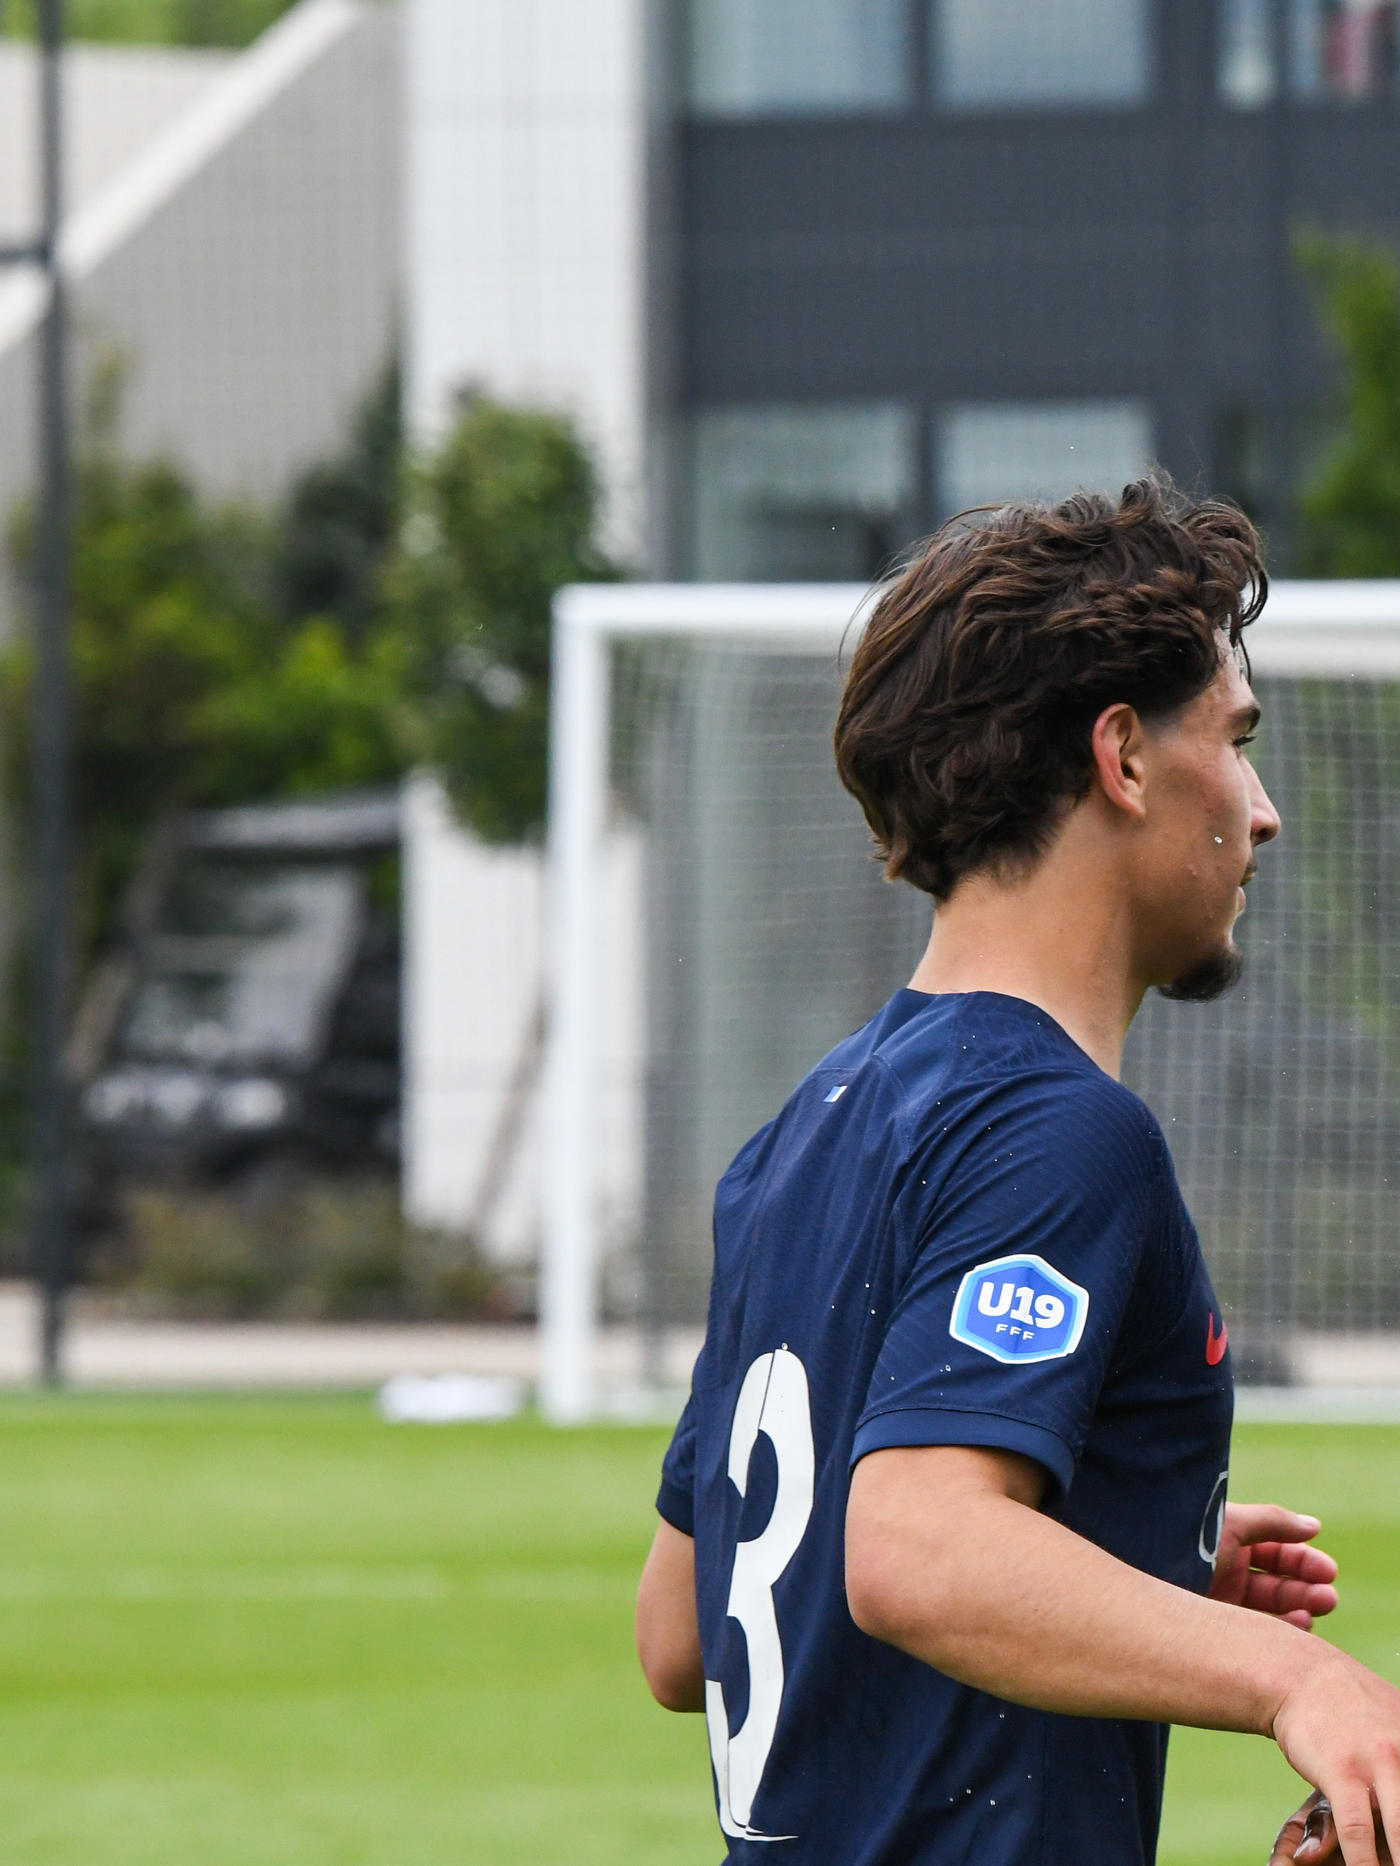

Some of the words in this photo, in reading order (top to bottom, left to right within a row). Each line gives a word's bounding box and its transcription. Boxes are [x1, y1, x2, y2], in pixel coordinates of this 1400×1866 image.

[977, 1281, 1065, 1329] U19
[995, 1323, 1035, 1340] FFF
[705, 1348, 815, 1841] 3
